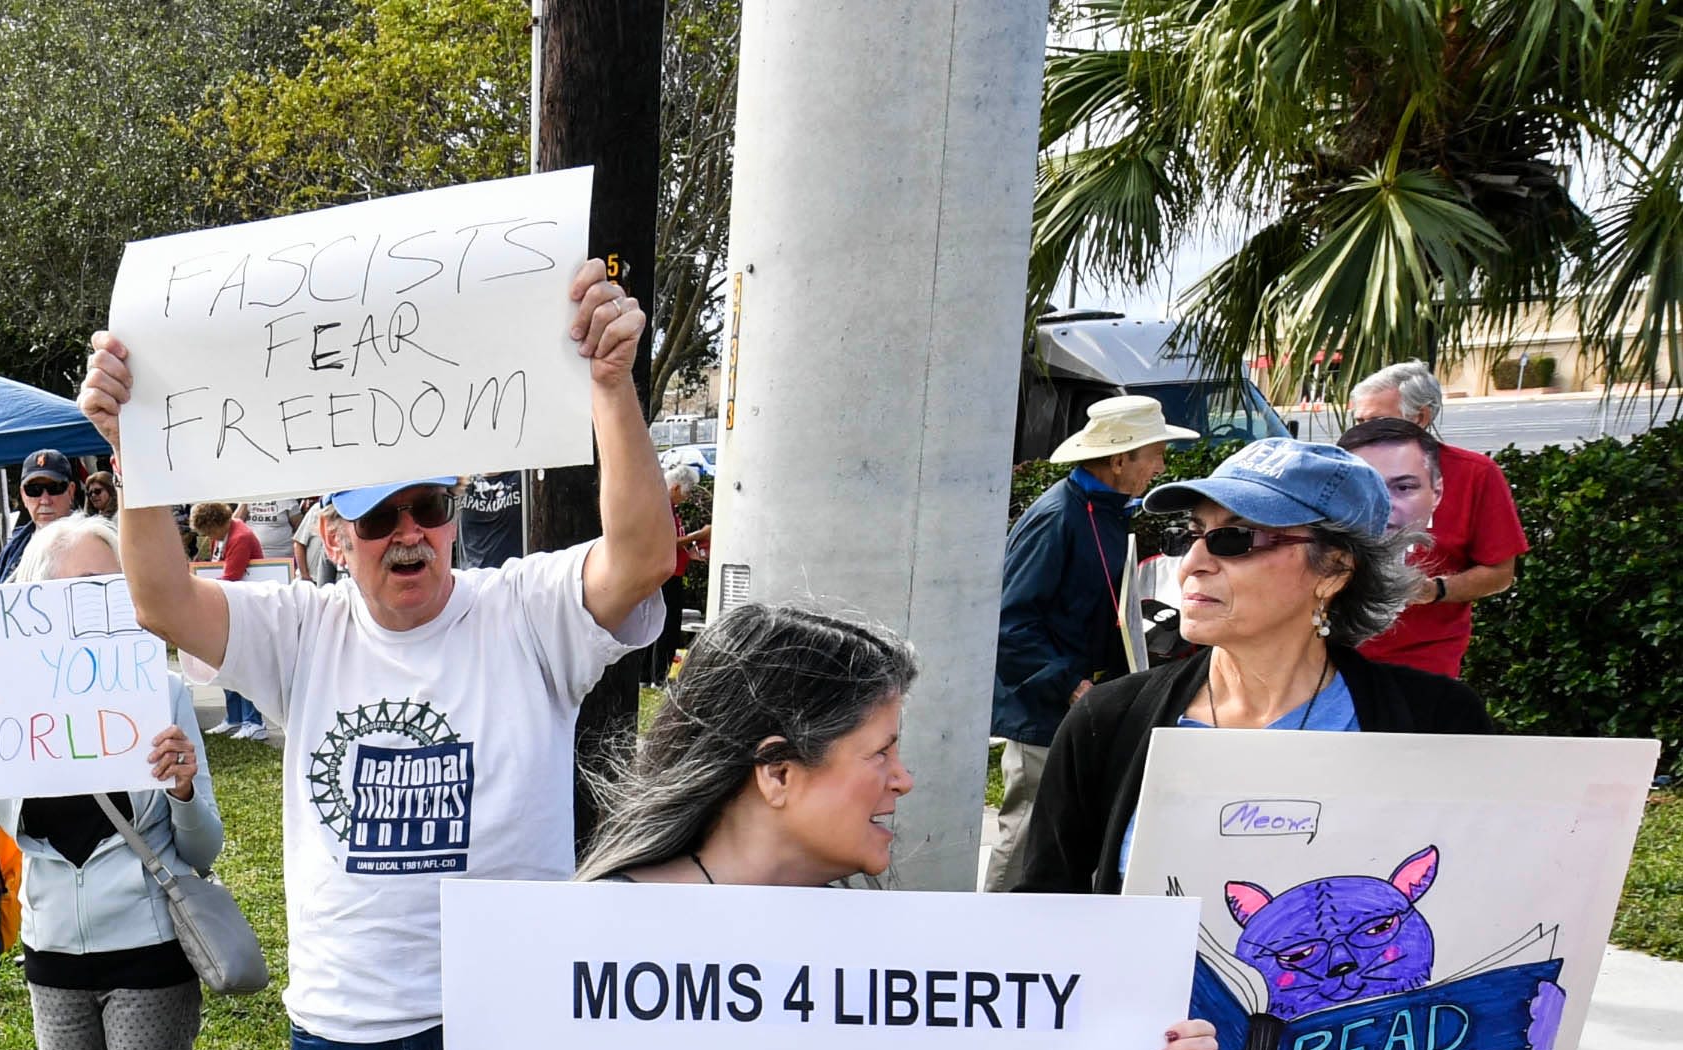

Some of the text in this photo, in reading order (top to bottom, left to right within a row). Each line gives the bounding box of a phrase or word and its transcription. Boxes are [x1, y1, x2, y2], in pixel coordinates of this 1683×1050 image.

[164, 216, 558, 317] FASCISTS
[264, 301, 460, 377] FEAR
[163, 370, 527, 471] FREEDOM
[41, 640, 157, 698] YOUR
[359, 749, 467, 786] national
[357, 783, 466, 819] WRITERS
[355, 820, 463, 846] union
[357, 860, 375, 870] UAW
[376, 861, 400, 871] LOCAL
[572, 960, 1081, 1030] MOMS 4 LIBERTY
